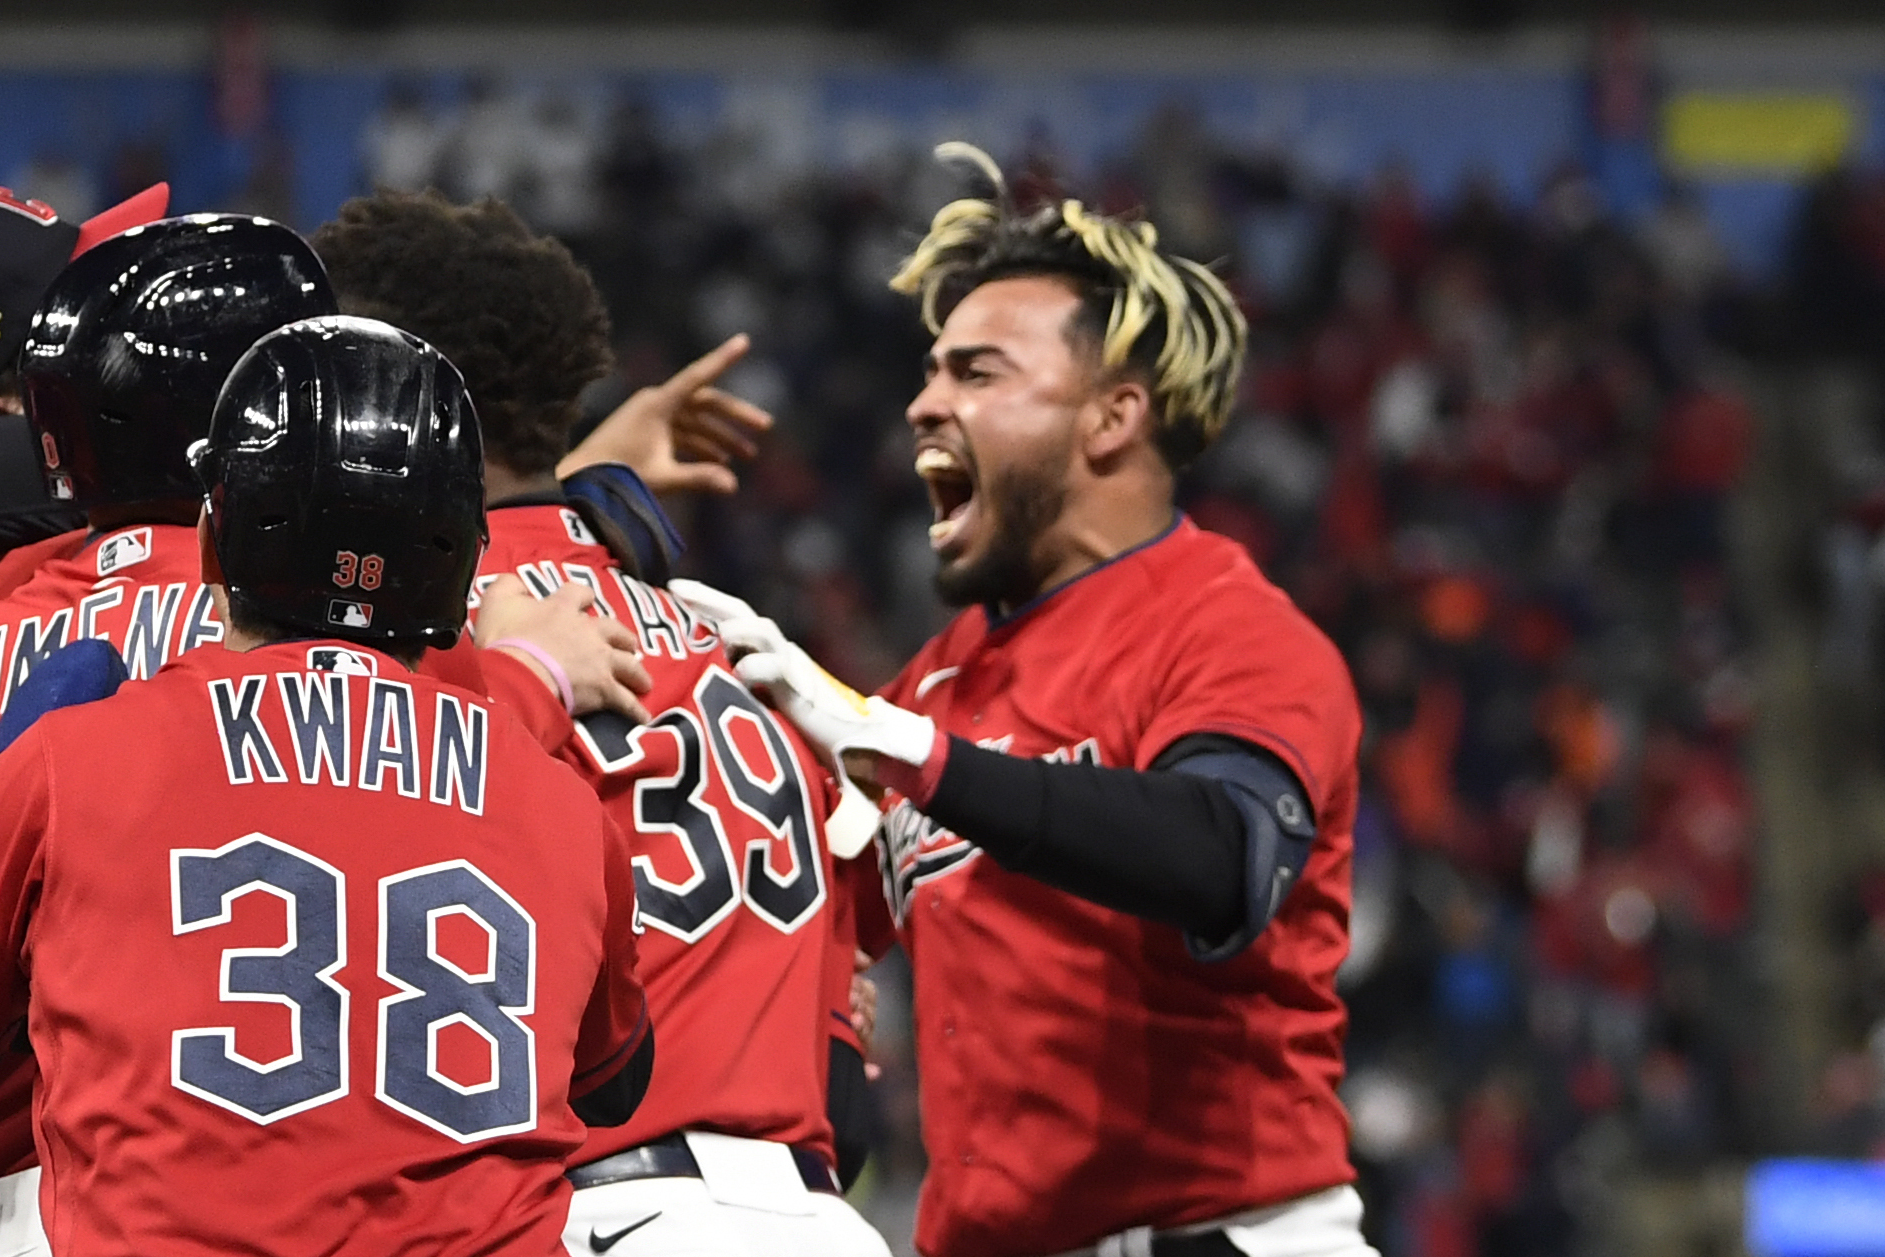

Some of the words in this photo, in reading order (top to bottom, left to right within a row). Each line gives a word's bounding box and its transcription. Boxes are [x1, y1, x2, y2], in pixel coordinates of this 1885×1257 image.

[333, 550, 384, 592] 38
[207, 671, 488, 816] KWAN
[574, 663, 827, 944] 39
[170, 831, 538, 1144] 38
